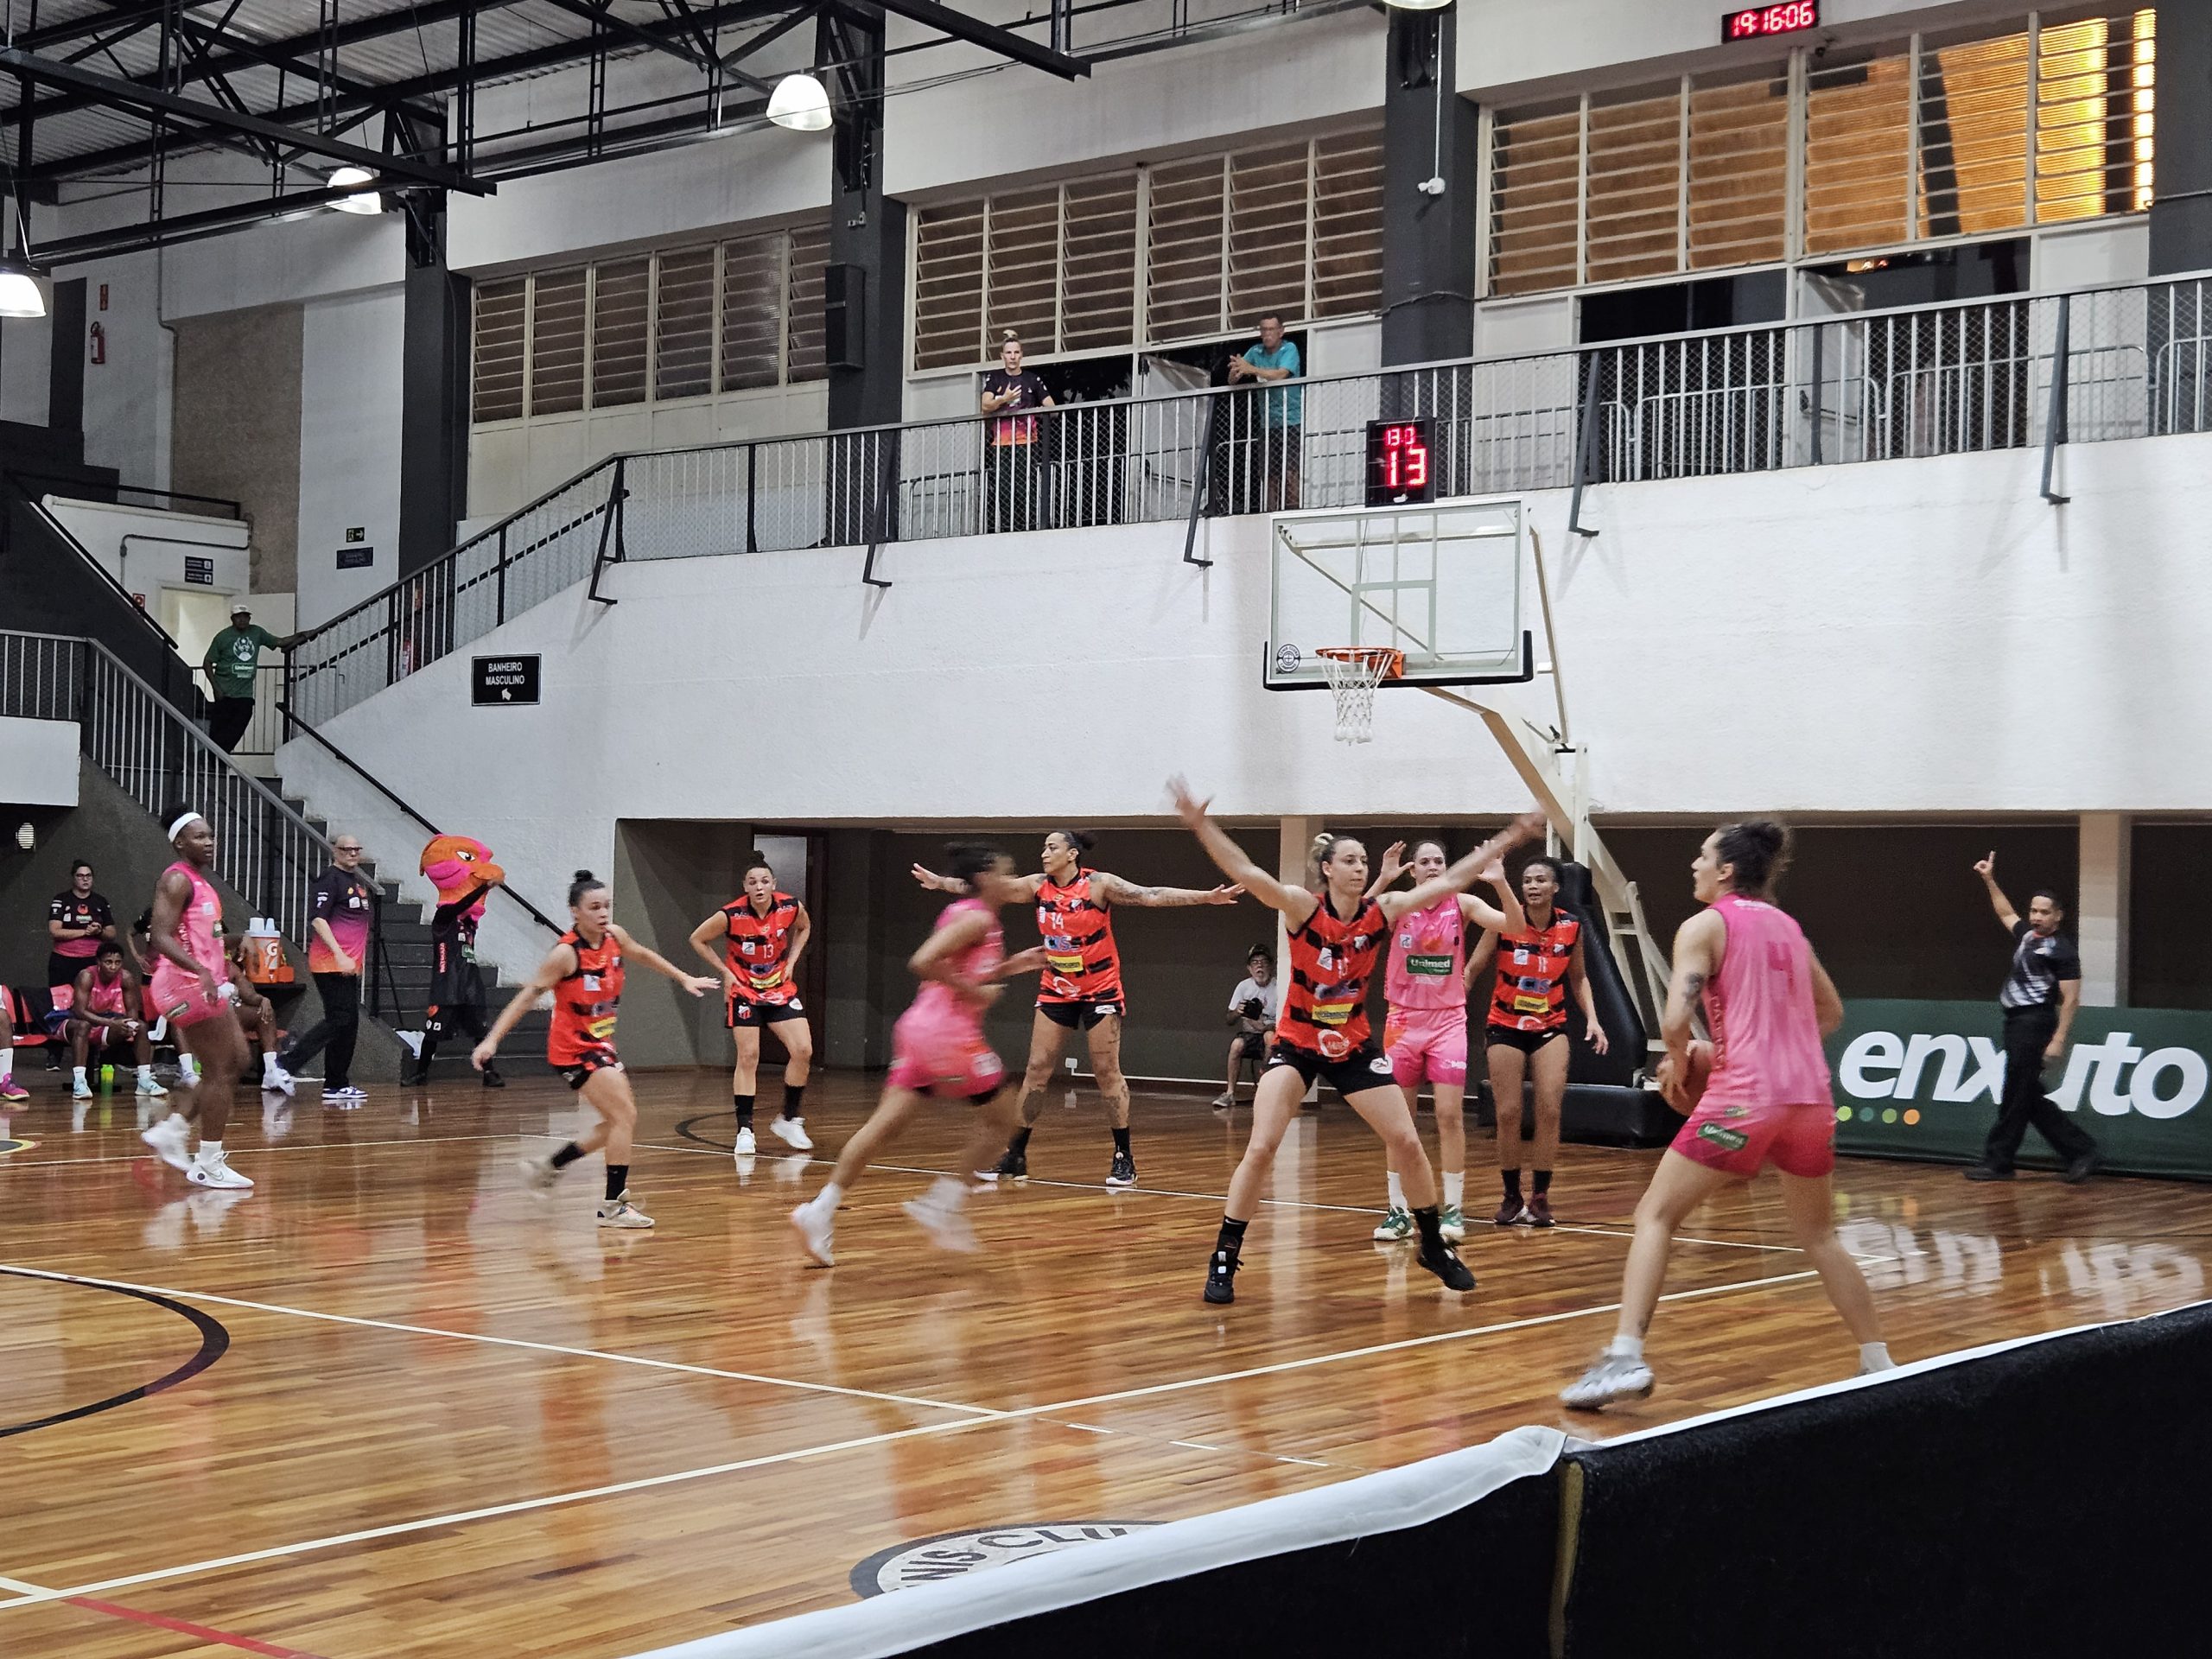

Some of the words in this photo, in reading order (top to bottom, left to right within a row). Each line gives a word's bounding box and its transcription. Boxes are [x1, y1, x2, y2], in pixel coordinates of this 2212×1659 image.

[1389, 448, 1427, 486] 13
[488, 662, 523, 672] BANHEIRO
[486, 675, 525, 685] MASCULINO
[1051, 912, 1064, 930] 14
[267, 942, 277, 957] G
[763, 944, 774, 959] 13
[1410, 959, 1451, 968] Unimed
[1766, 941, 1796, 995] 4
